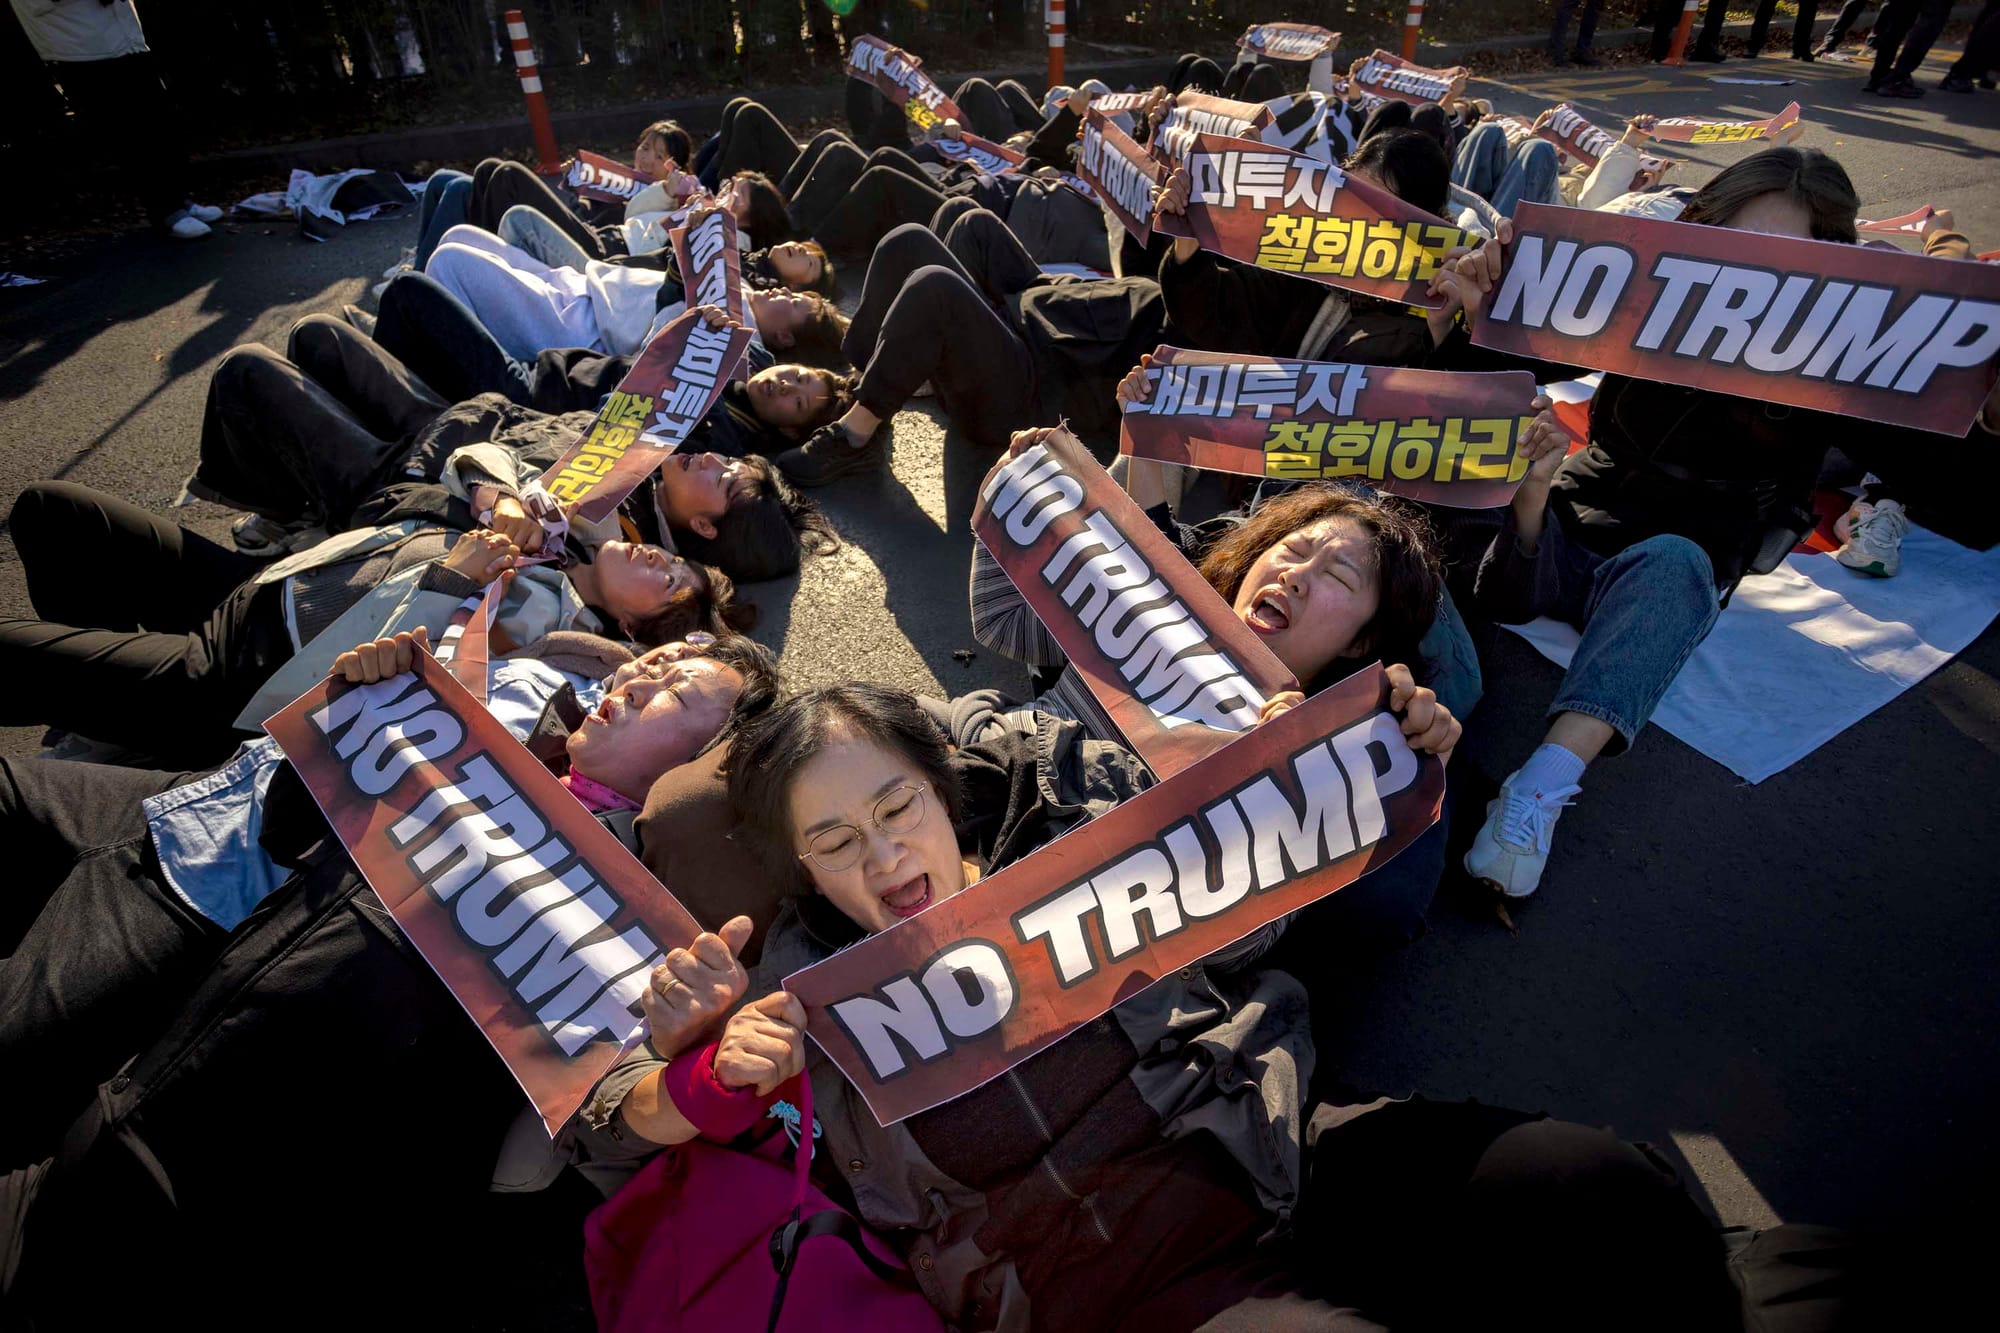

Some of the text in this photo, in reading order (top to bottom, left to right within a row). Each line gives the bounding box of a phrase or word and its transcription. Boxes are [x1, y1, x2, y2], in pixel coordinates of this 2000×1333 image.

[1356, 58, 1393, 85] NO
[1082, 122, 1157, 225] NO TRUMP
[1183, 150, 1346, 214] 미투자
[1490, 235, 2000, 393] NO TRUMP
[1125, 363, 1368, 417] 대미투자
[982, 443, 1267, 733] NO TRUMP
[311, 671, 463, 796] NO
[833, 711, 1418, 1078] NO TRUMP
